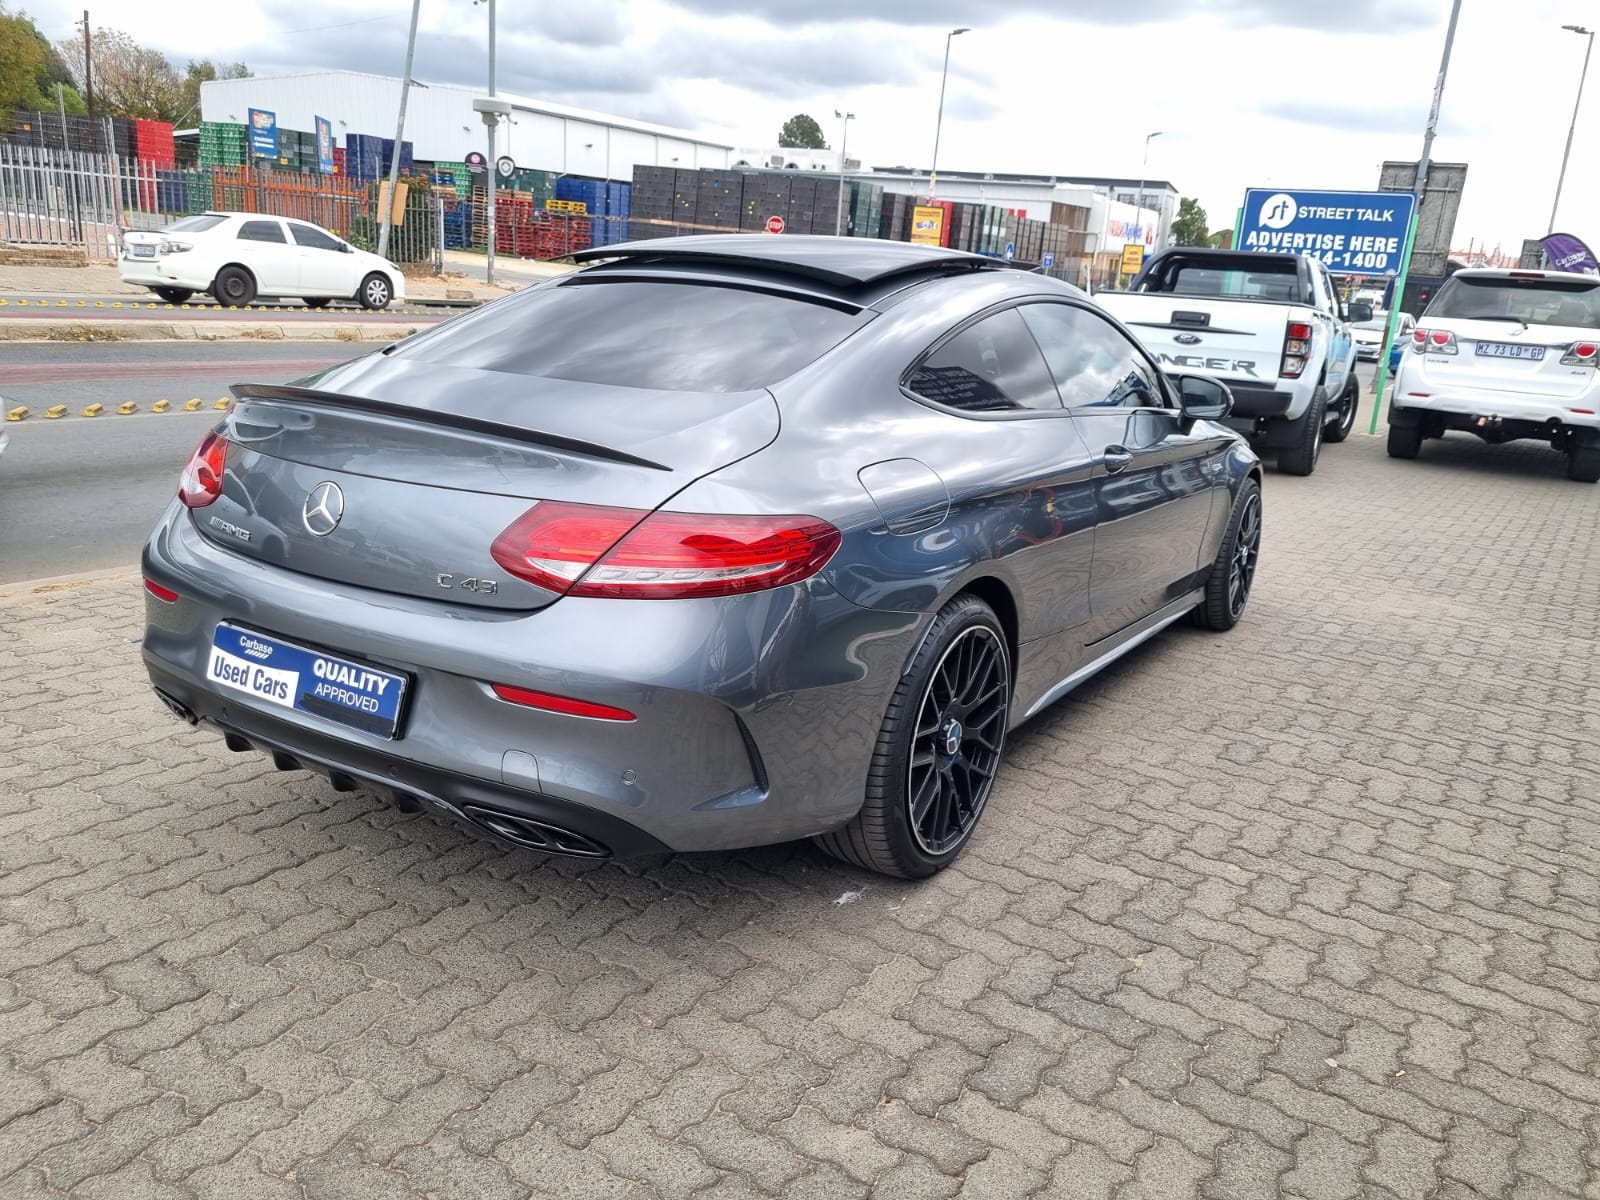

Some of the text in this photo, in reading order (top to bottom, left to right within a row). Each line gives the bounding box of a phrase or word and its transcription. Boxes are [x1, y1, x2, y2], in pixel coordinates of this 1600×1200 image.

[1298, 206, 1353, 220] STREET
[1355, 208, 1394, 222] TALK
[1246, 230, 1399, 253] ADVERTISE HERE
[1494, 345, 1506, 355] 73
[1530, 348, 1543, 358] GP
[217, 518, 252, 541] AMG
[437, 573, 498, 595] C 43
[239, 635, 273, 655] Carbase
[213, 655, 289, 700] Used Cars
[313, 658, 390, 696] QUALITY
[314, 682, 379, 713] APPROVED
